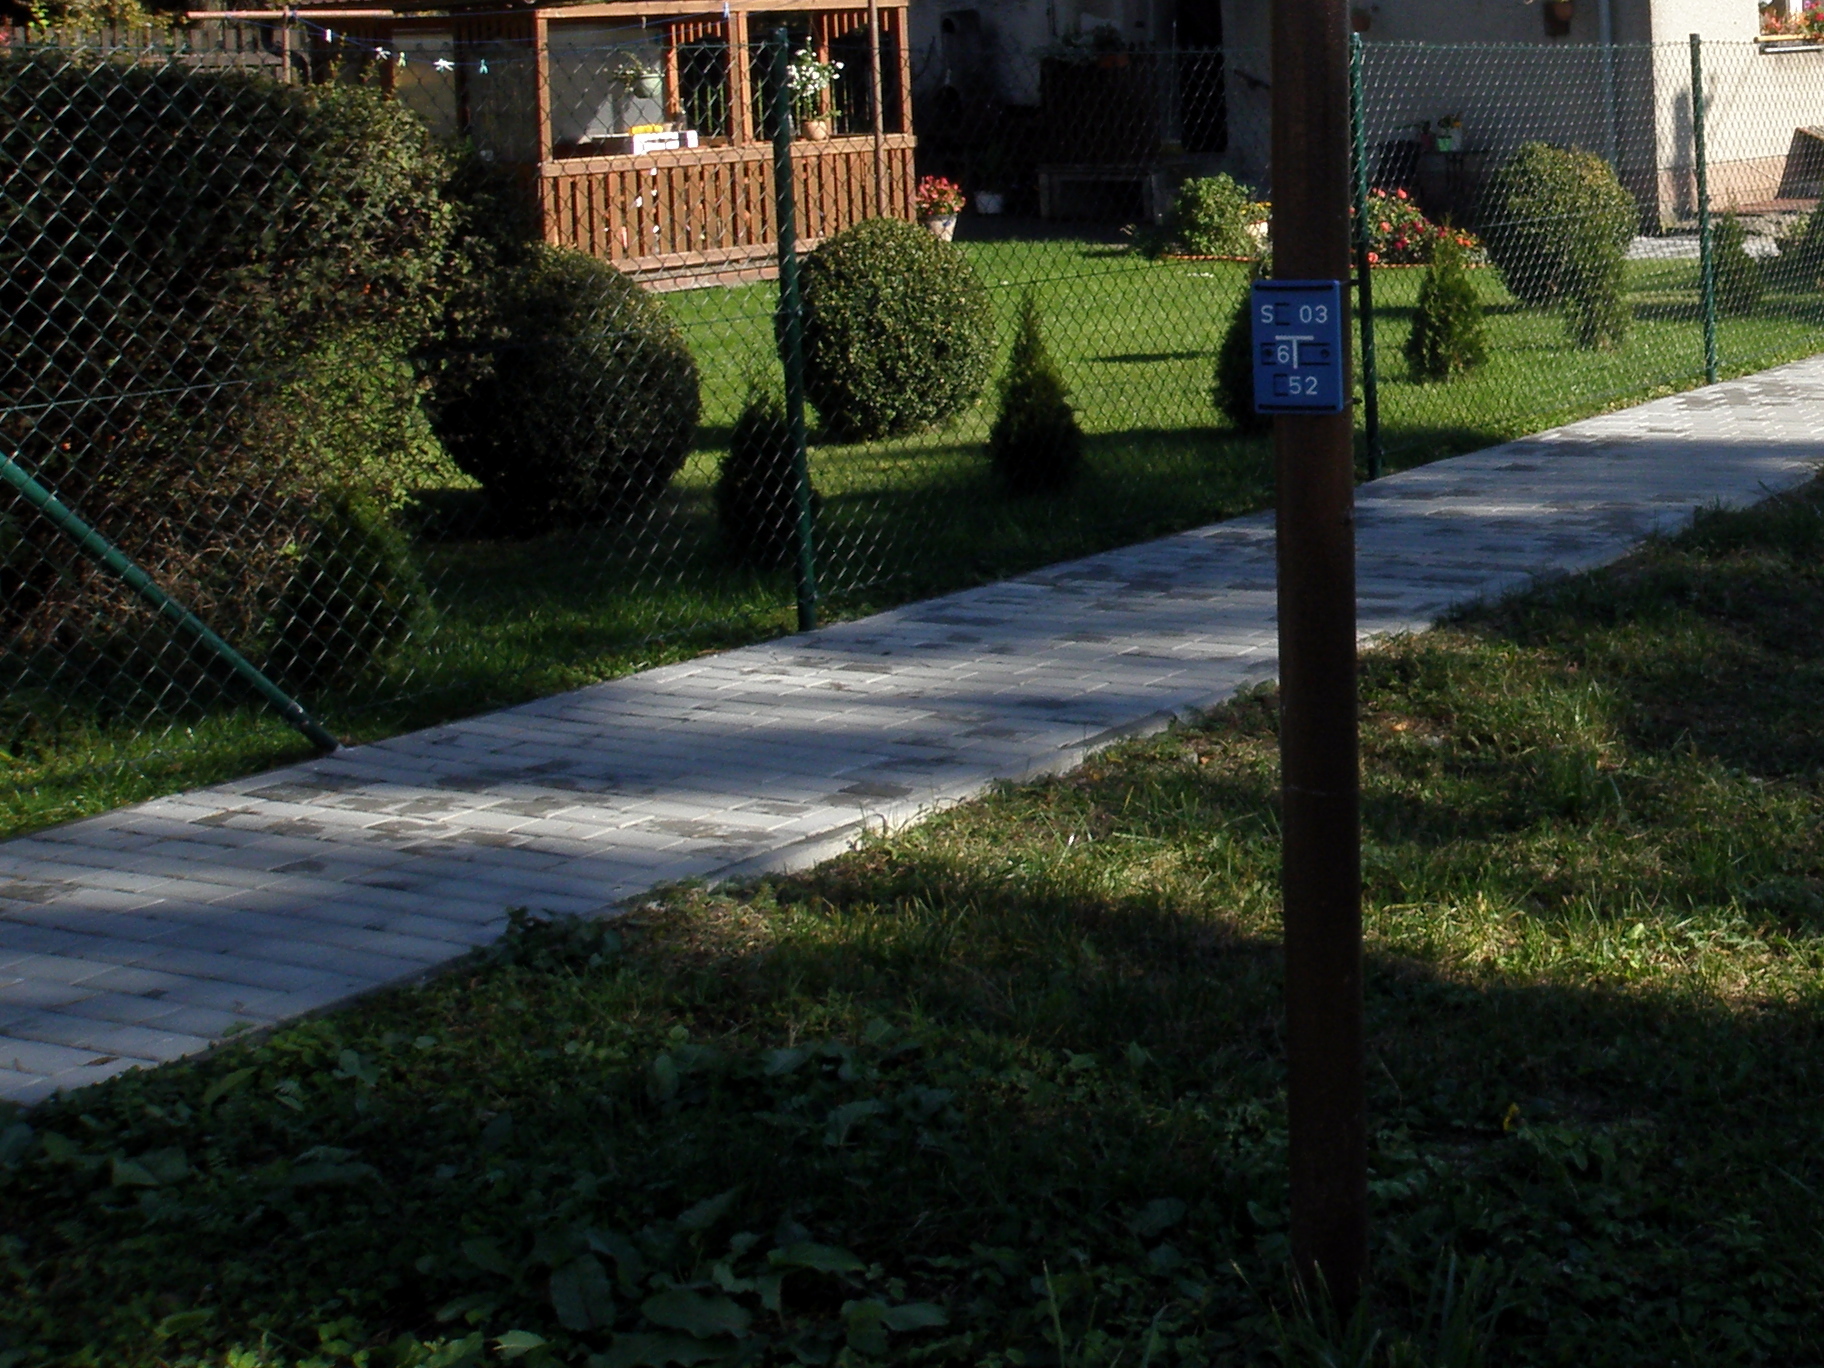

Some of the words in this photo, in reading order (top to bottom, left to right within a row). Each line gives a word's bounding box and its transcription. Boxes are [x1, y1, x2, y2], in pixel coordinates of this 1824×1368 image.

[1261, 305, 1274, 323] S
[1300, 305, 1328, 323] 03
[1289, 376, 1318, 395] 52
